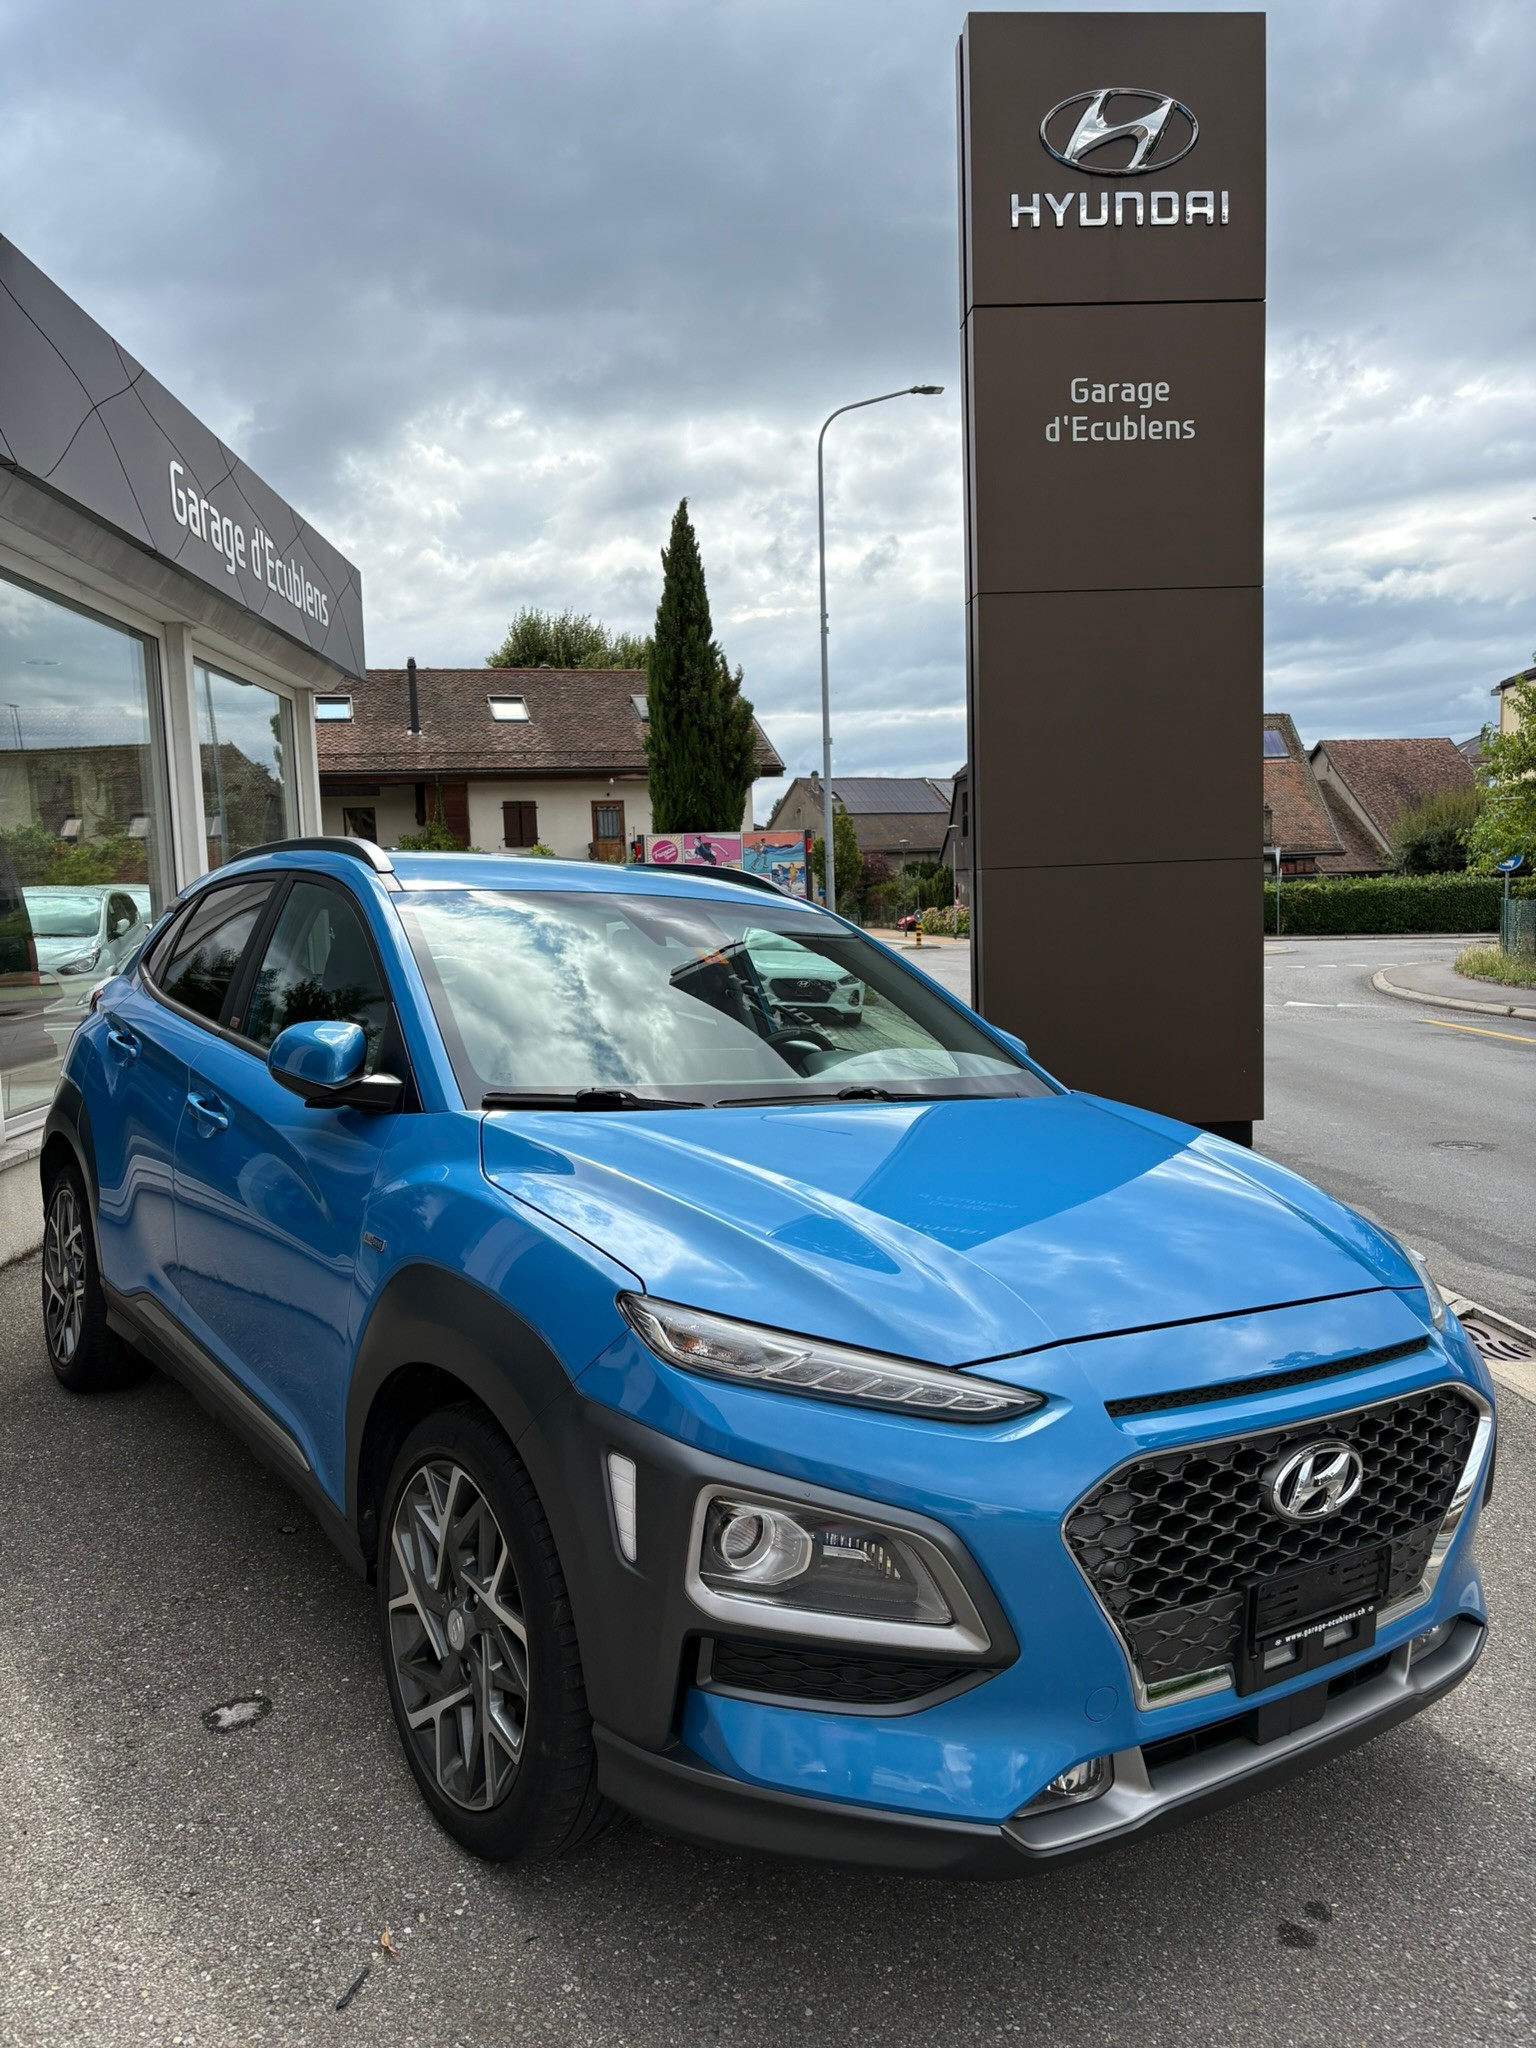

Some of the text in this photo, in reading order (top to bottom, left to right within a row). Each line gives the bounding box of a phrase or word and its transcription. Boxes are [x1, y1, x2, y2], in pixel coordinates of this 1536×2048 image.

[1010, 190, 1230, 229] HYUNDAI
[1070, 377, 1170, 409] Garage
[1045, 414, 1196, 443] d'Ecublens
[168, 459, 330, 627] Garage d'Ecublens
[1284, 1607, 1367, 1643] www.garage-ecublens.ch
